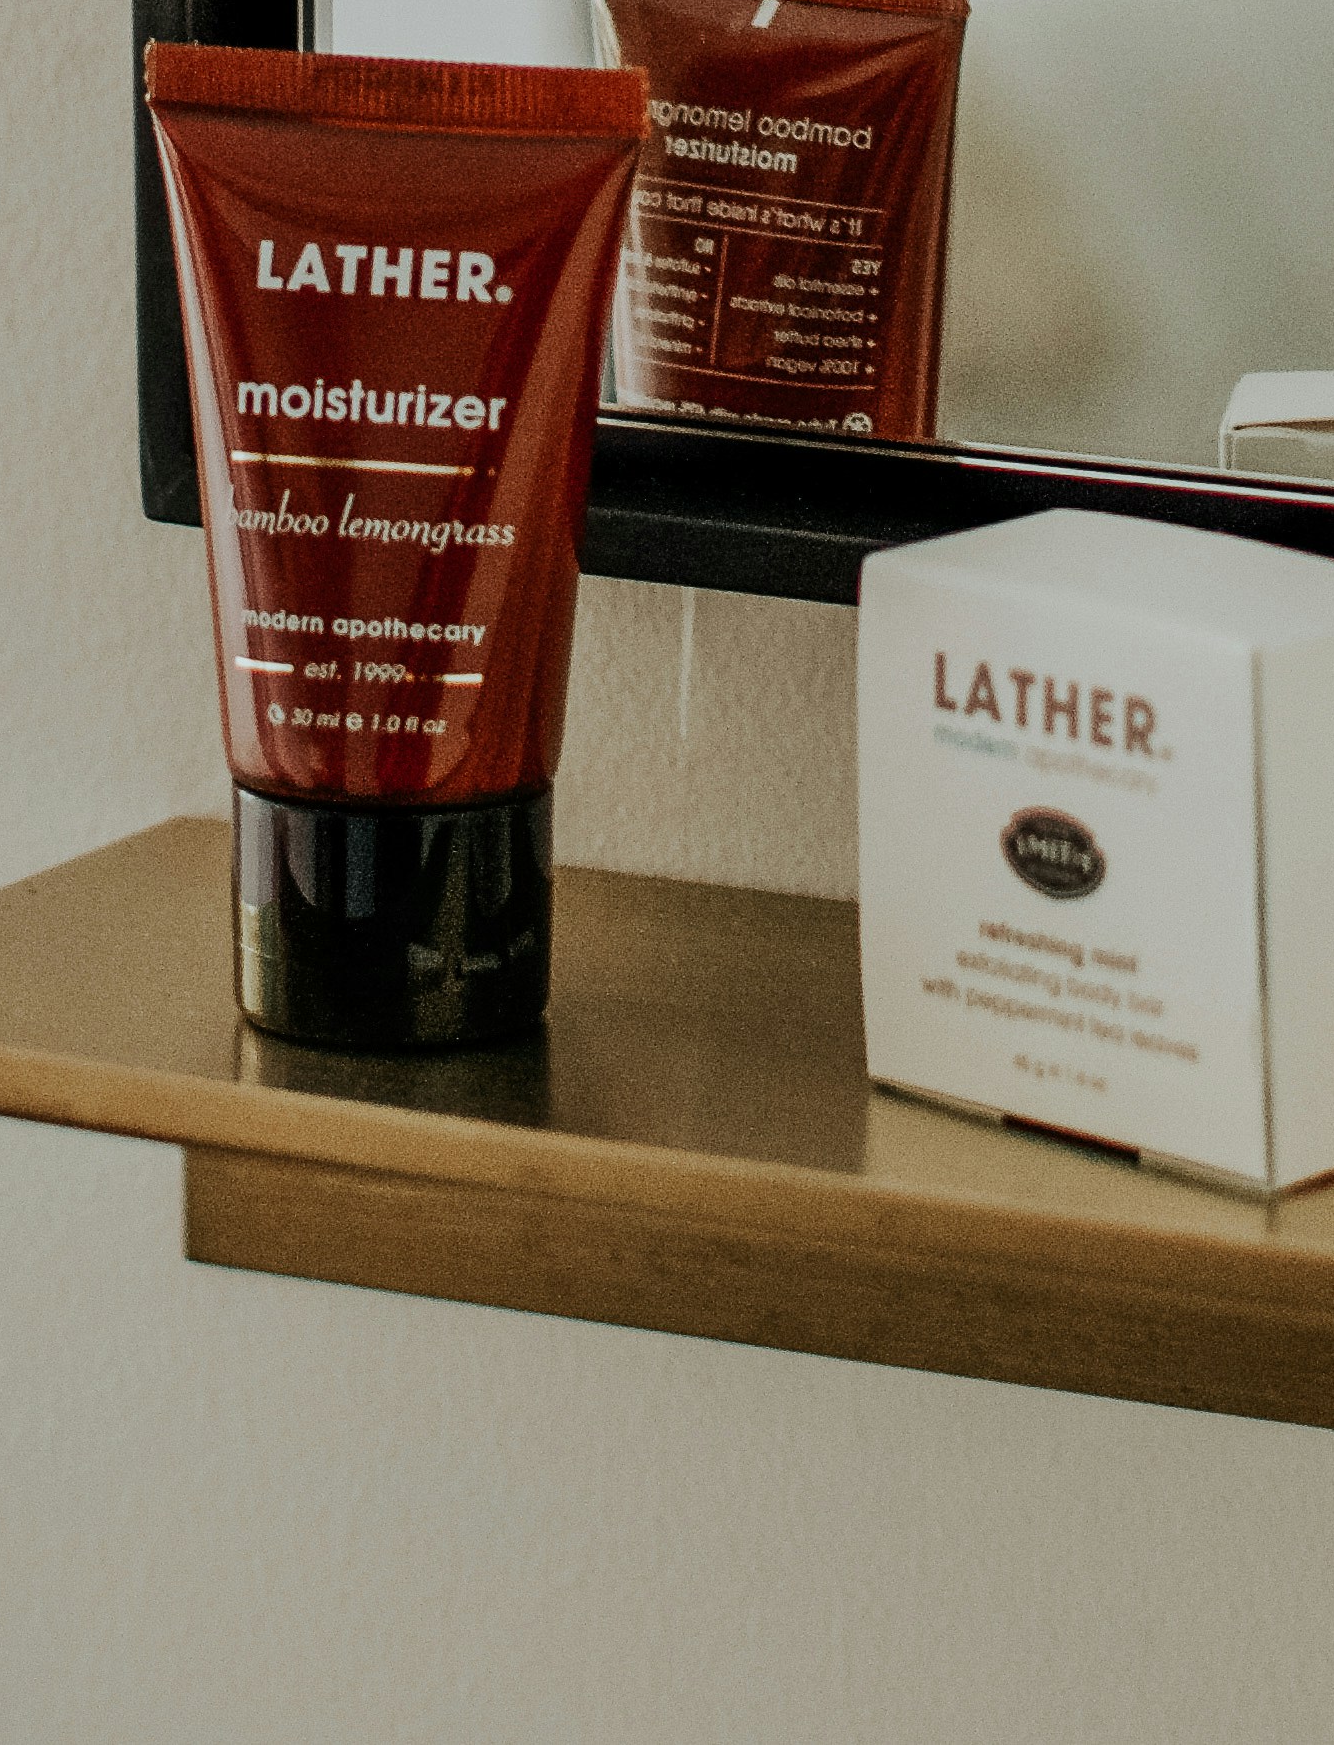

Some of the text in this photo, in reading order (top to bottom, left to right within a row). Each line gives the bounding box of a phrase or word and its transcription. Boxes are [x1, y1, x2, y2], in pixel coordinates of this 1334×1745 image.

[256, 239, 515, 305] LATHER.
[237, 378, 507, 431] moisturizer
[337, 492, 516, 555] lemongrass
[242, 609, 486, 647] modern apothecary
[303, 660, 343, 681] est.
